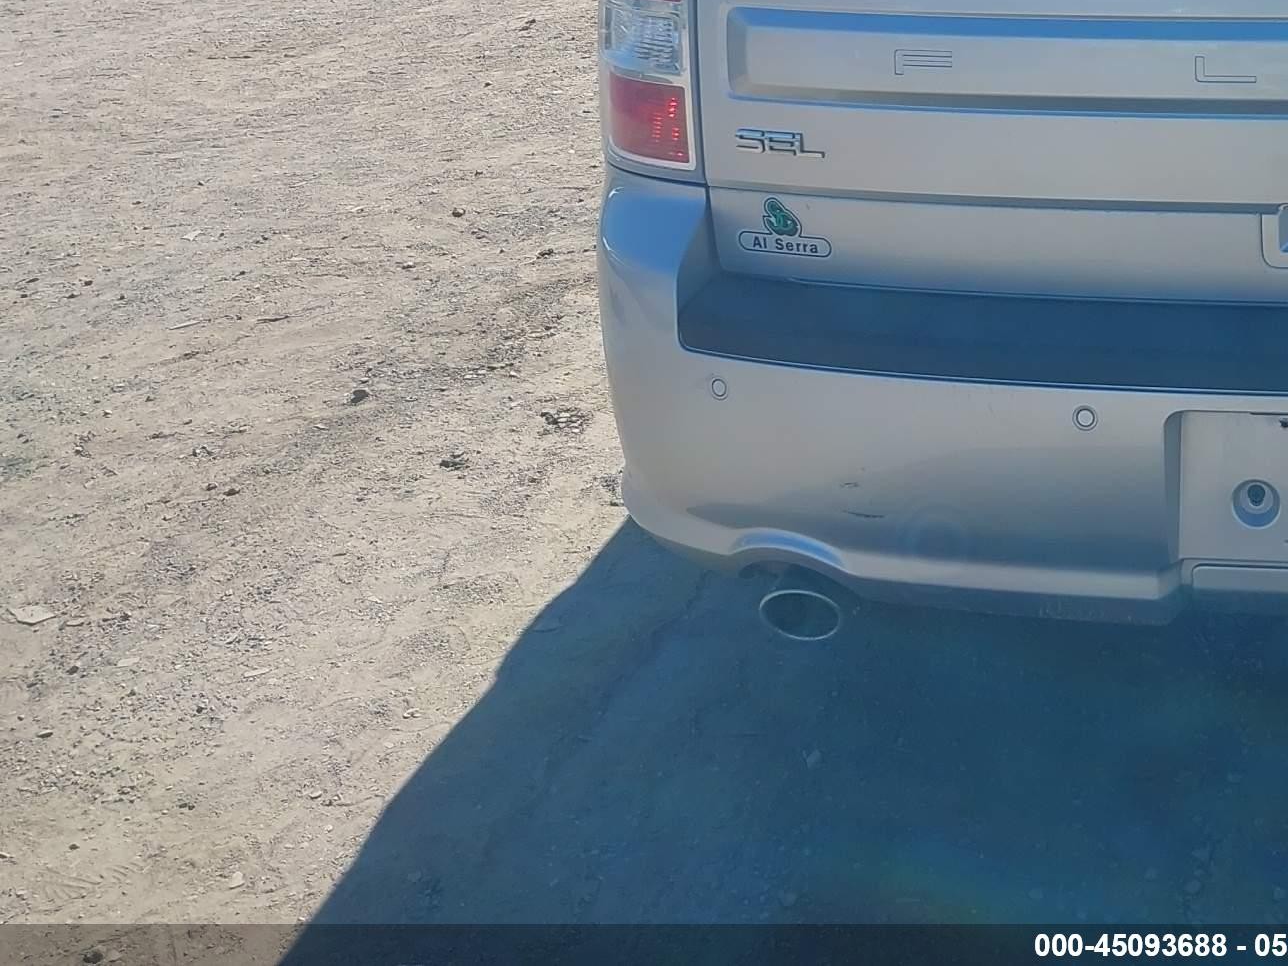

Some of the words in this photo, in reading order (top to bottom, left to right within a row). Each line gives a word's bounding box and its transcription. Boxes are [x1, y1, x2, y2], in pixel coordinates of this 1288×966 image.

[735, 128, 826, 159] SEL
[752, 236, 767, 249] Al
[775, 238, 818, 254] Serra
